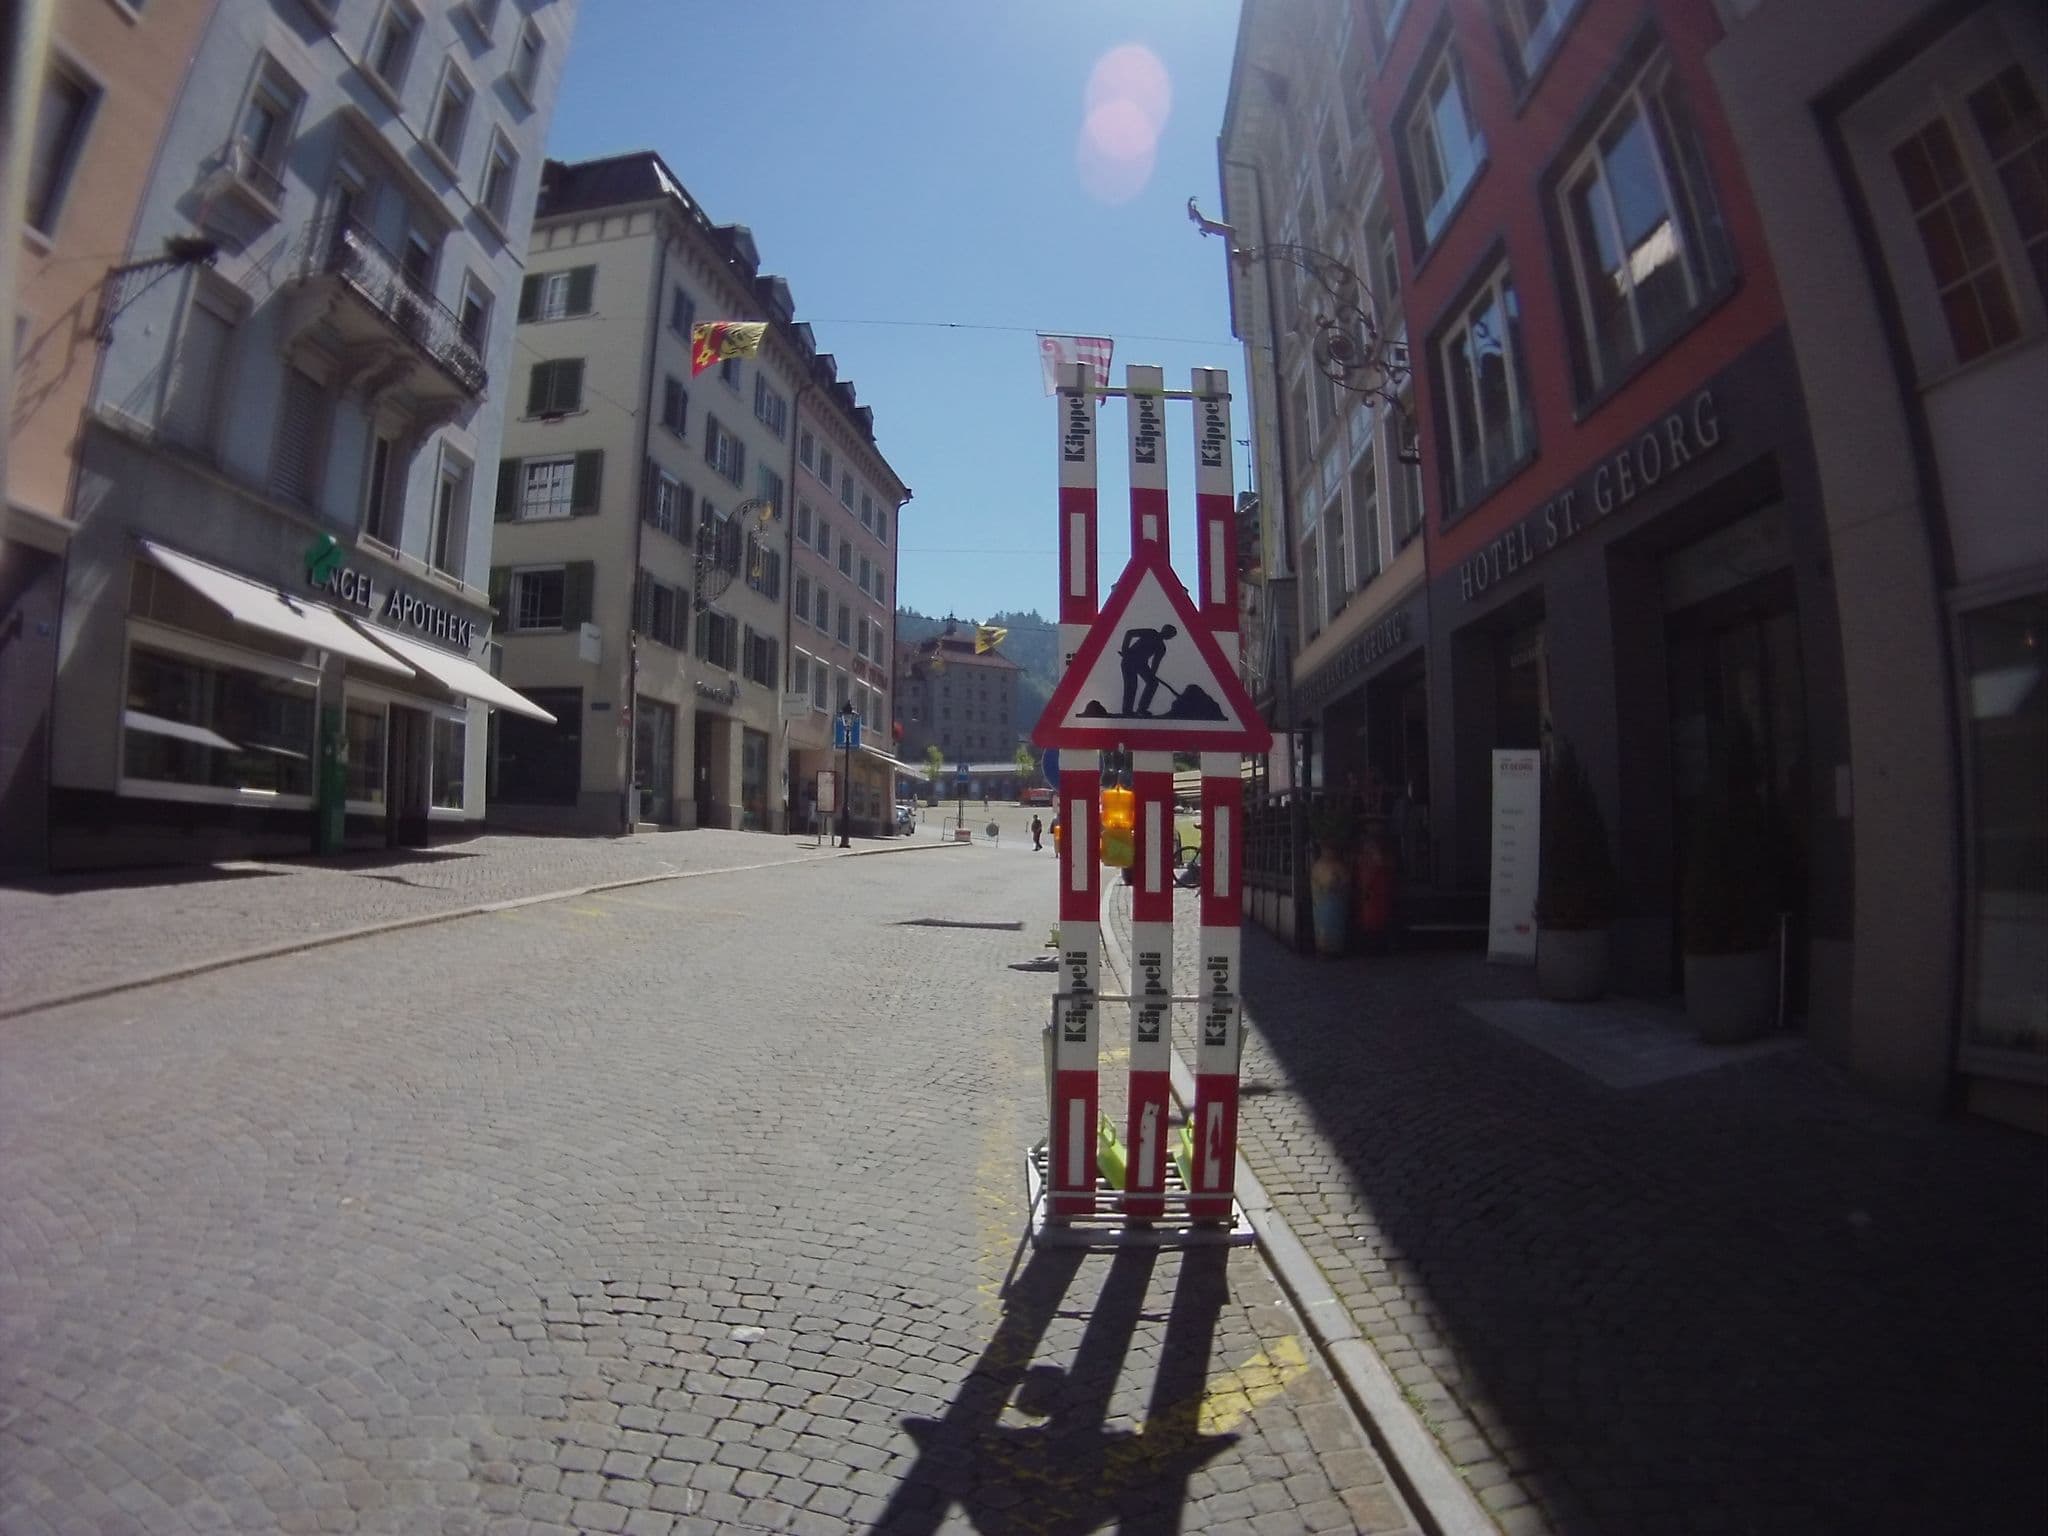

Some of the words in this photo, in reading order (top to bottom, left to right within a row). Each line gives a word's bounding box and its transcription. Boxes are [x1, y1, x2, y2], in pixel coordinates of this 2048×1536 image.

[1458, 522, 1534, 600] HOTEL
[1544, 491, 1581, 547] ST.
[1593, 390, 1720, 515] GEORG
[388, 590, 476, 648] APOTHEKE
[1363, 611, 1401, 663] GEORG
